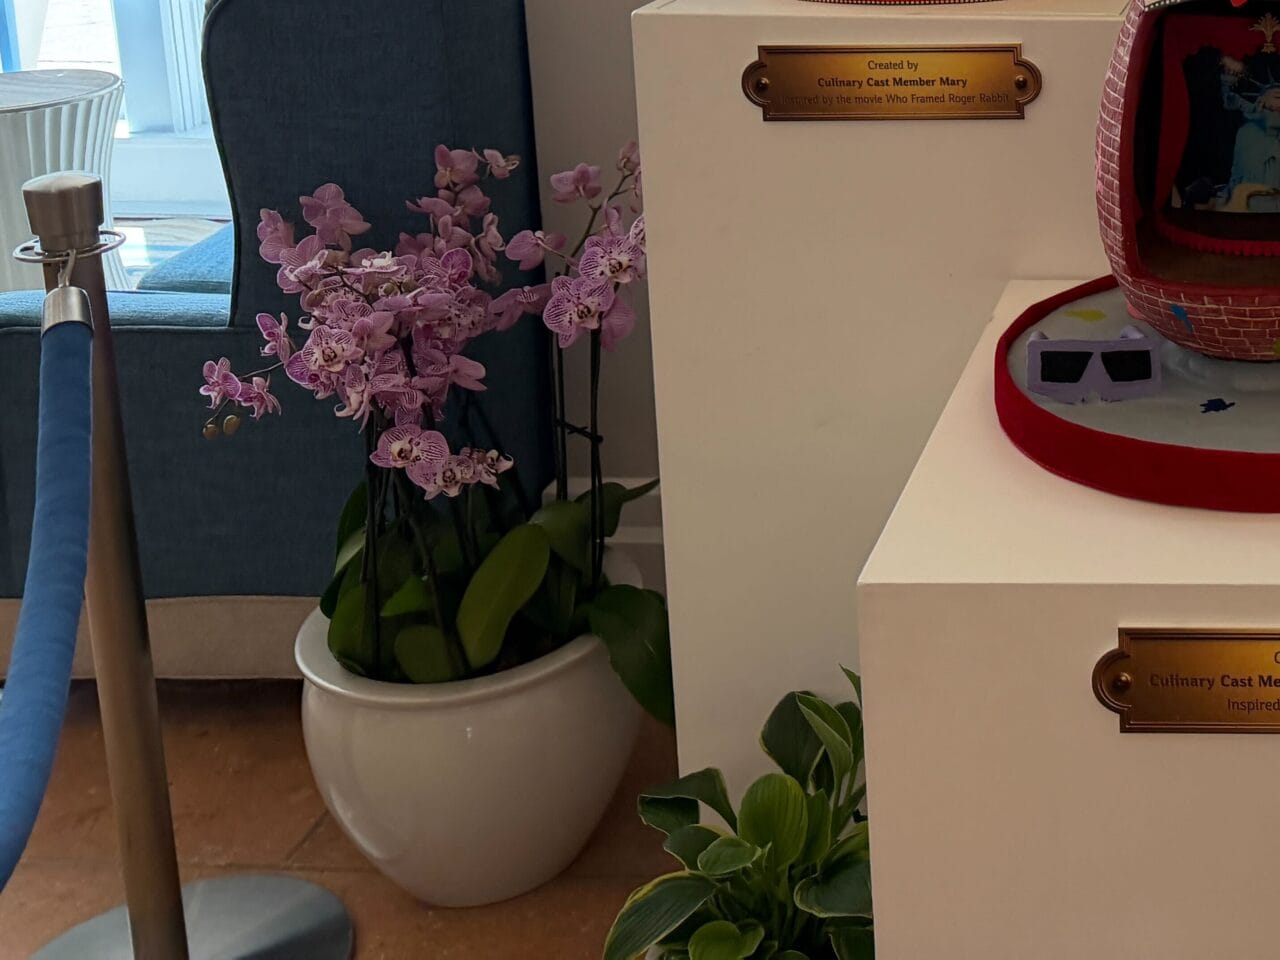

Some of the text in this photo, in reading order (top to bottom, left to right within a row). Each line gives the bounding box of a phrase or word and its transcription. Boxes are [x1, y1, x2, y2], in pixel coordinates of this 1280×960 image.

[867, 60, 918, 72] Created by
[817, 77, 968, 89] Culinary Cast Member Mary
[821, 95, 833, 106] by
[836, 95, 851, 104] the
[855, 94, 883, 104] movie
[885, 94, 908, 104] Who
[911, 93, 945, 104] Framed
[948, 93, 976, 105] Roger
[980, 93, 1009, 104] Rabbit
[1150, 674, 1215, 690] Culinary
[1220, 674, 1253, 687] Cast
[1227, 698, 1280, 713] Inspired
